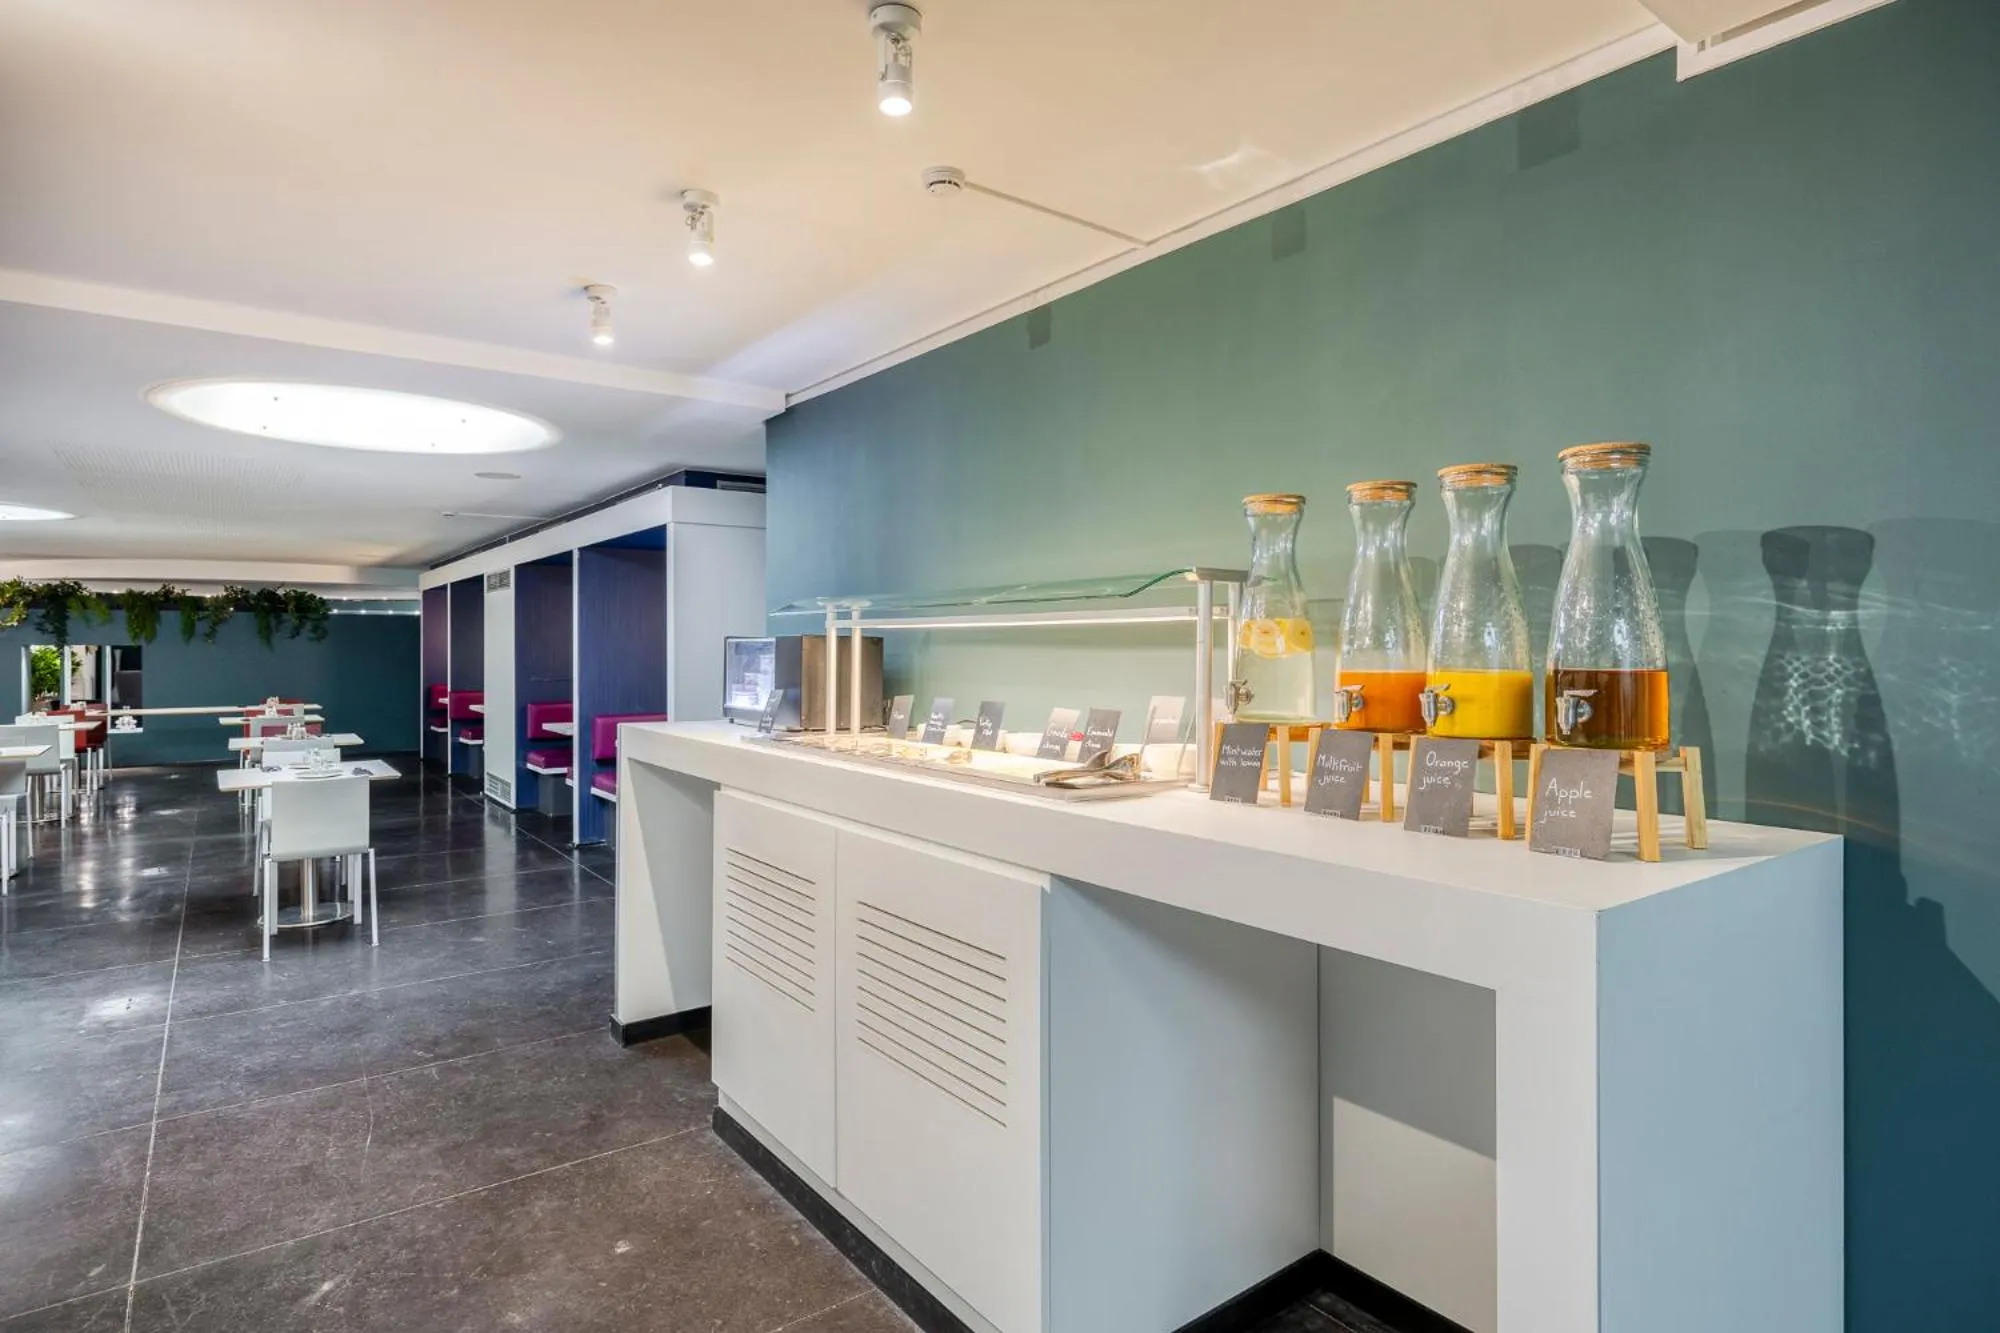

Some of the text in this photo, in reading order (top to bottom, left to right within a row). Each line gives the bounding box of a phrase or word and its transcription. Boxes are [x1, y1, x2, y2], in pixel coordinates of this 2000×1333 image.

[1426, 750, 1469, 775] Orange
[1318, 771, 1347, 786] juice
[1416, 771, 1452, 790] juice
[1544, 776, 1593, 805] Apple
[1534, 805, 1577, 825] juice
